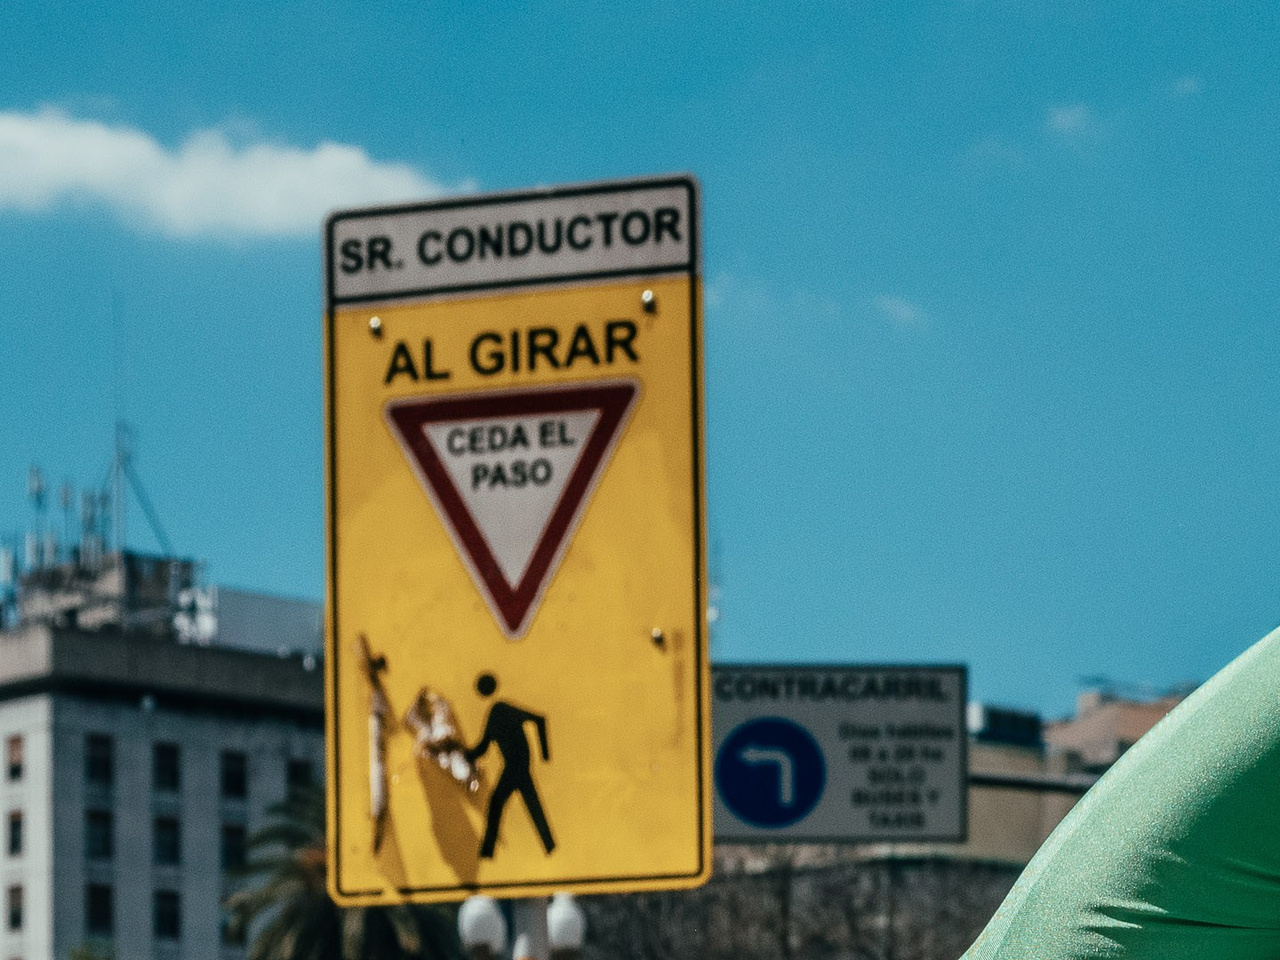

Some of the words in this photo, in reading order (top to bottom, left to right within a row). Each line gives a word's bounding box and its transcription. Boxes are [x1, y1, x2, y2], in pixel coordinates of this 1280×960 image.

[340, 235, 403, 273] SR.
[417, 206, 682, 267] CONDUCTOR
[385, 339, 451, 385] AL
[469, 321, 639, 377] GIRAR
[446, 424, 530, 457] CEDA
[539, 419, 576, 448] EL
[471, 458, 553, 491] PASO
[714, 676, 950, 701] CONTRACARRIL
